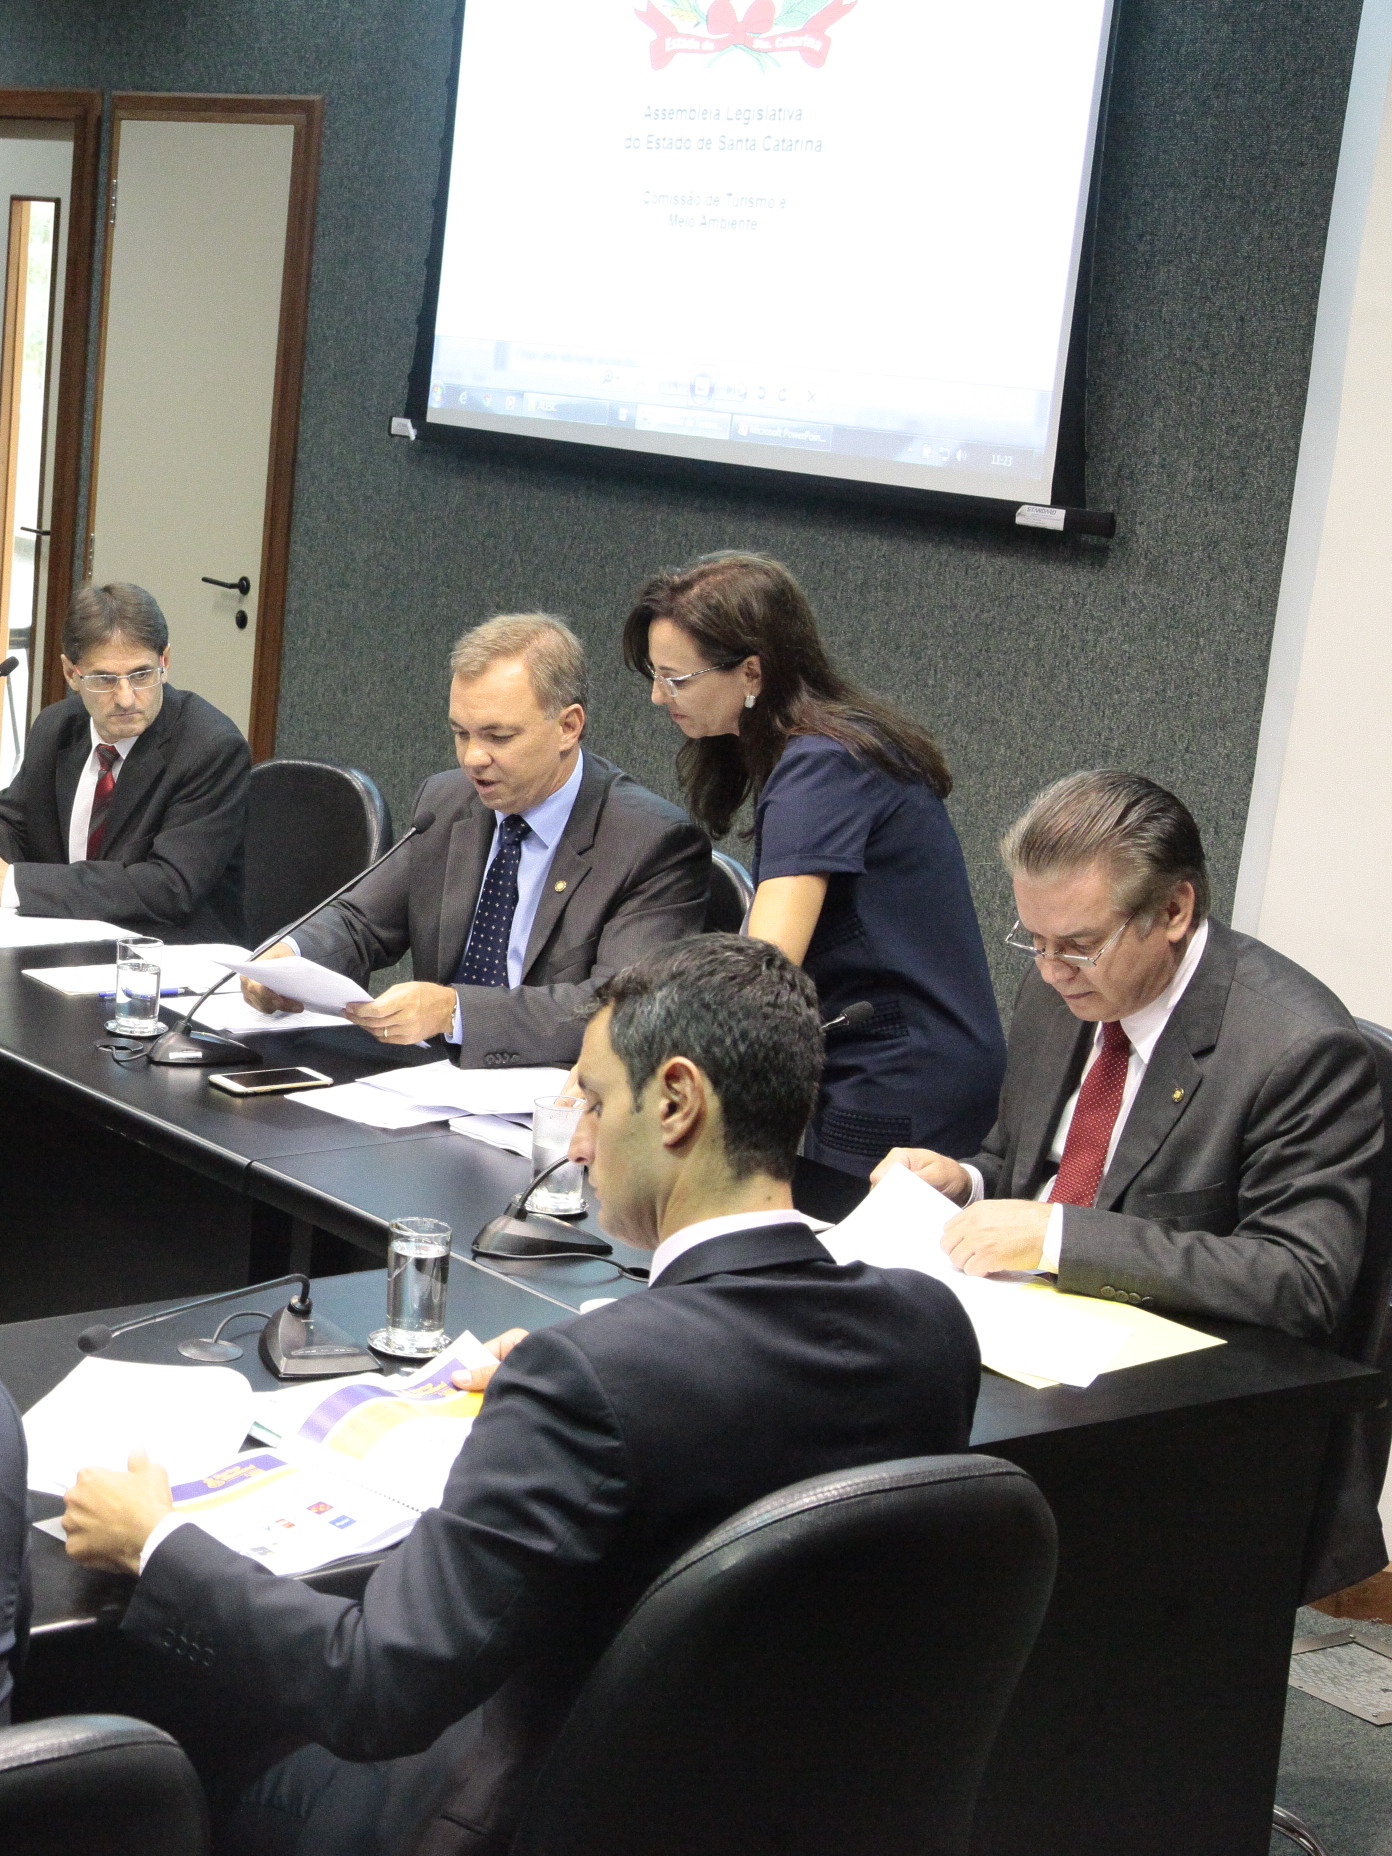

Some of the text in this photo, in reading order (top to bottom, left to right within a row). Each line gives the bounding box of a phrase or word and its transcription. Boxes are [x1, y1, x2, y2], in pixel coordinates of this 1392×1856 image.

[665, 36, 700, 51] Estado
[644, 105, 803, 125] Assembleia Legislativa
[624, 134, 823, 152] do Estado de Santa Catarina
[643, 190, 787, 208] Comissão de Turismo e
[668, 213, 758, 231] Meio Ambiente
[749, 424, 783, 438] Microsoft
[1027, 507, 1057, 515] STANDARD
